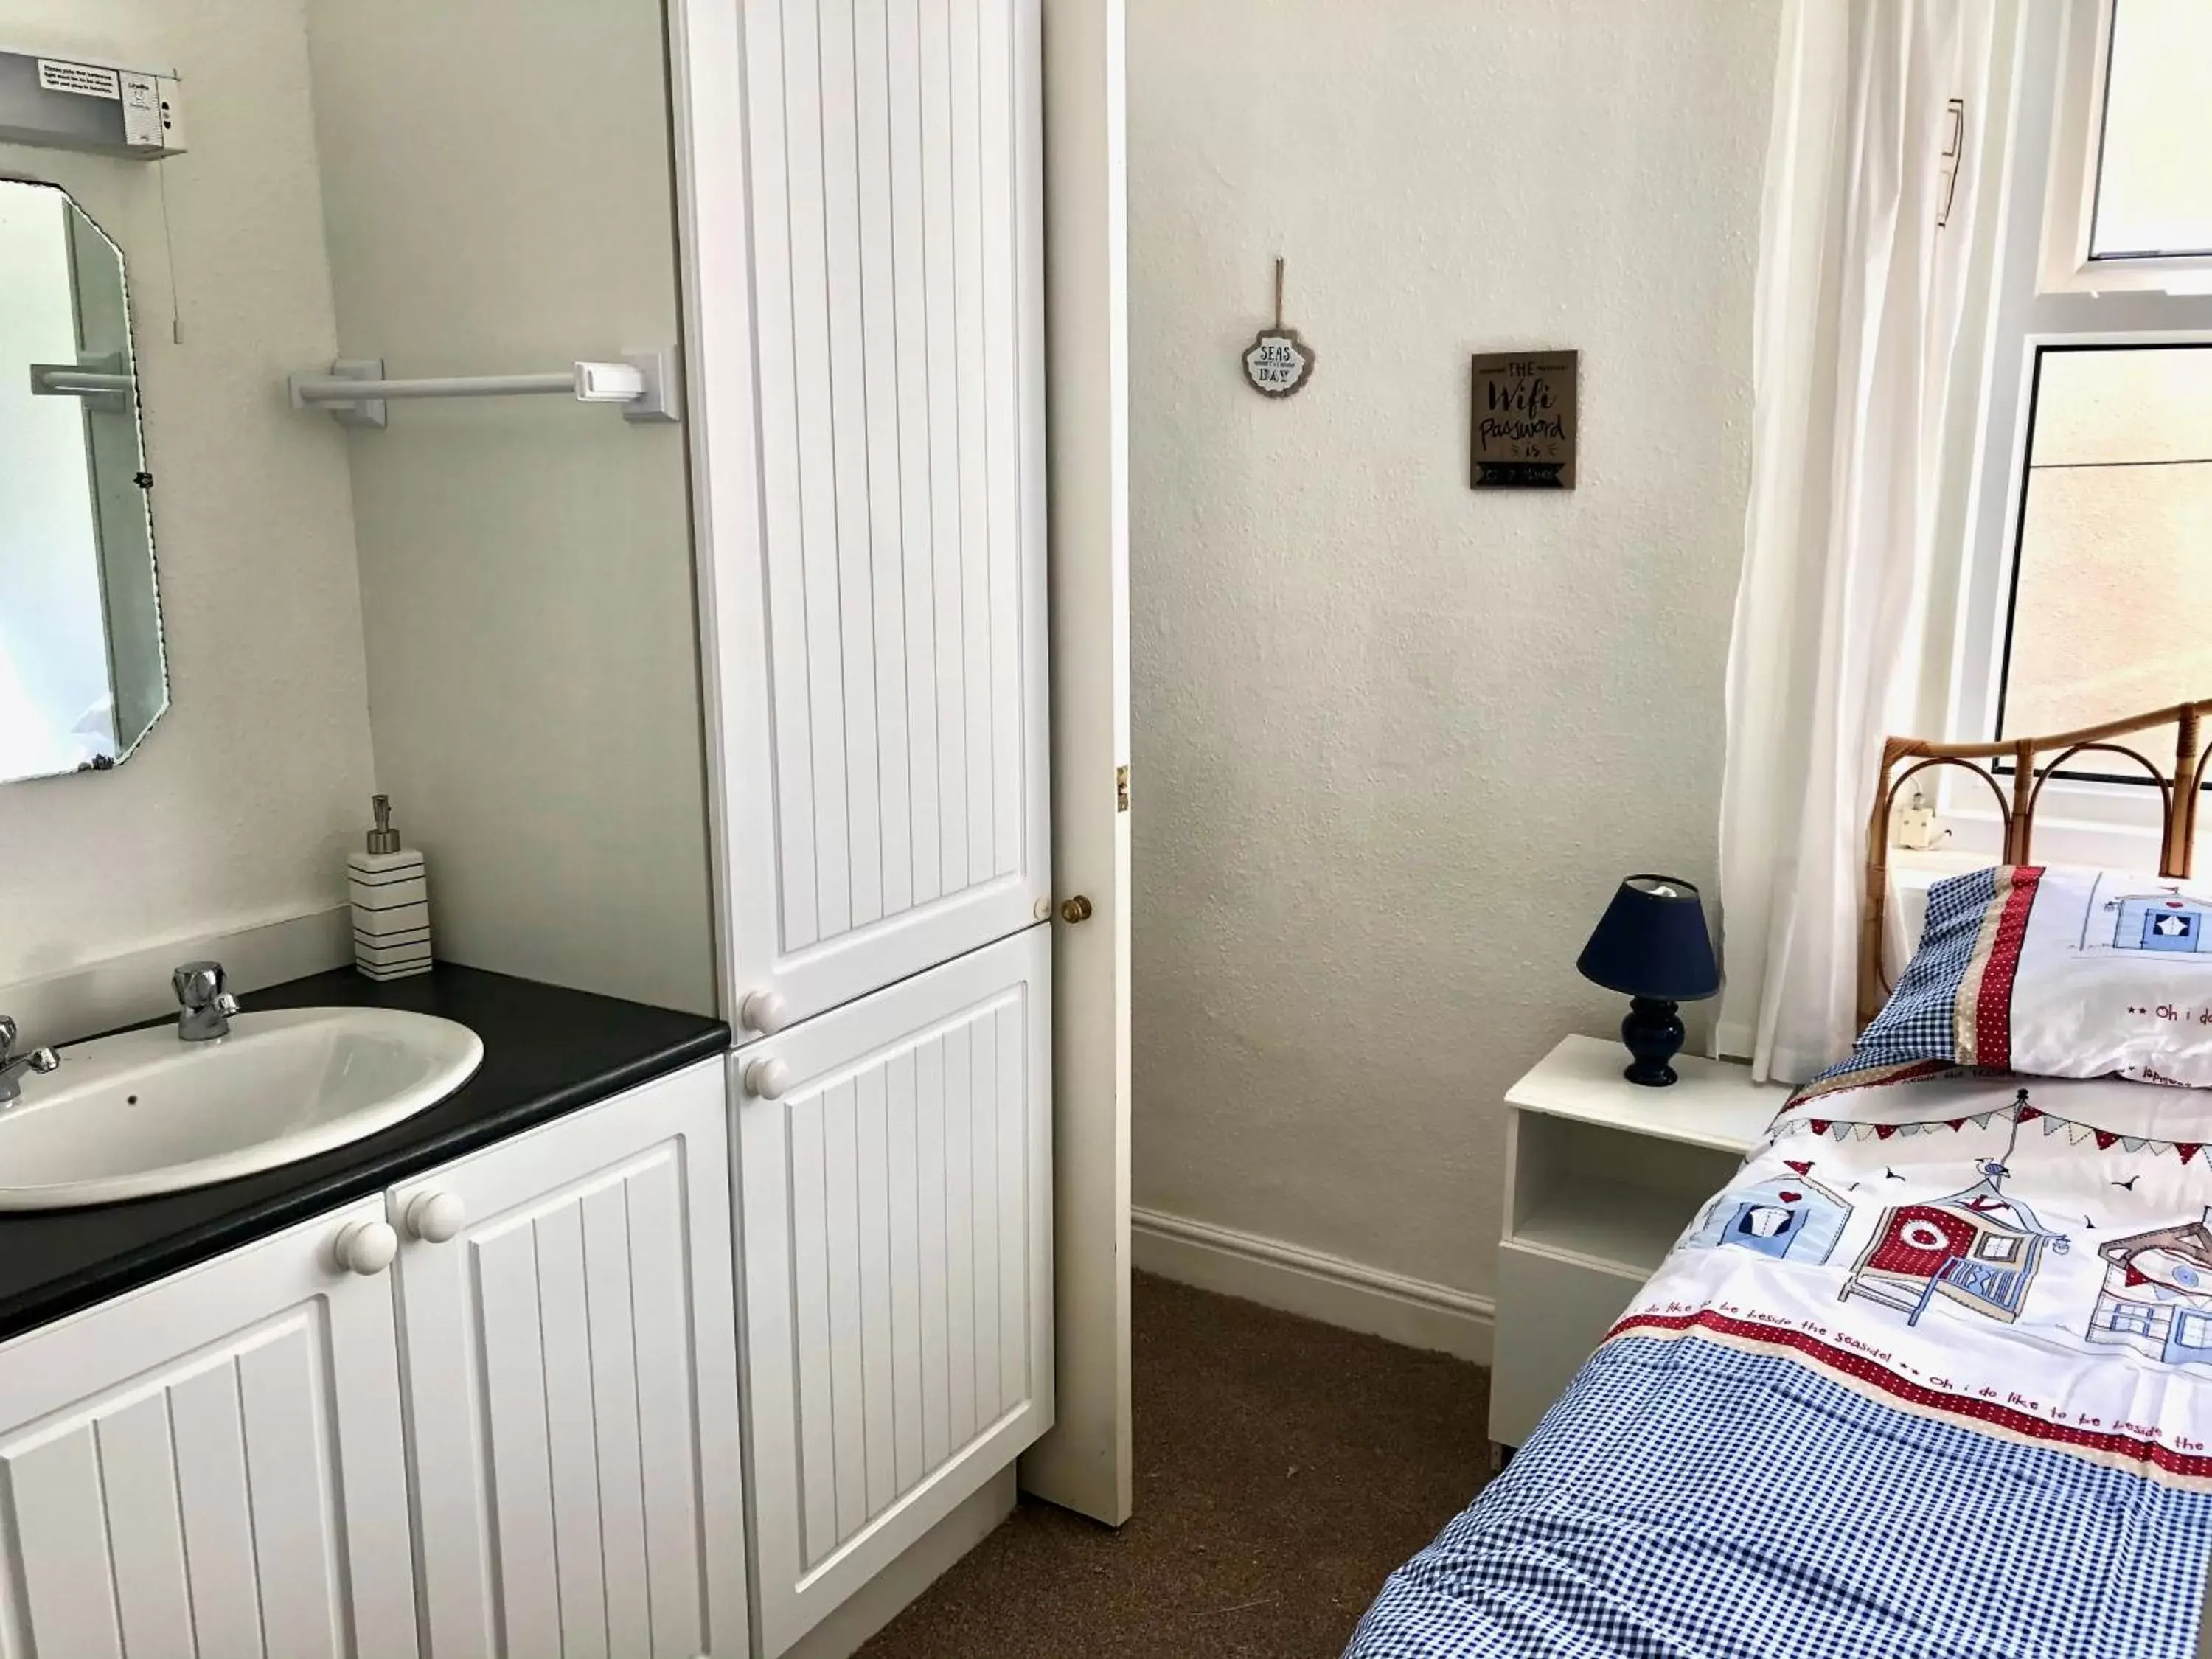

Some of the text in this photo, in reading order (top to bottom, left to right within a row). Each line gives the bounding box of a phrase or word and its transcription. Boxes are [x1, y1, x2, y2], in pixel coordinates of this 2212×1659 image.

[1260, 346, 1290, 361] SEAS
[1259, 369, 1290, 383] DAY
[1509, 361, 1535, 377] THE
[2155, 1004, 2177, 1021] Oh
[1801, 1321, 1826, 1336] the
[1929, 1377, 1953, 1390] Oh
[1979, 1386, 1997, 1397] do
[2008, 1392, 2039, 1411] like
[2051, 1406, 2067, 1419] to
[2175, 1436, 2204, 1450] the
